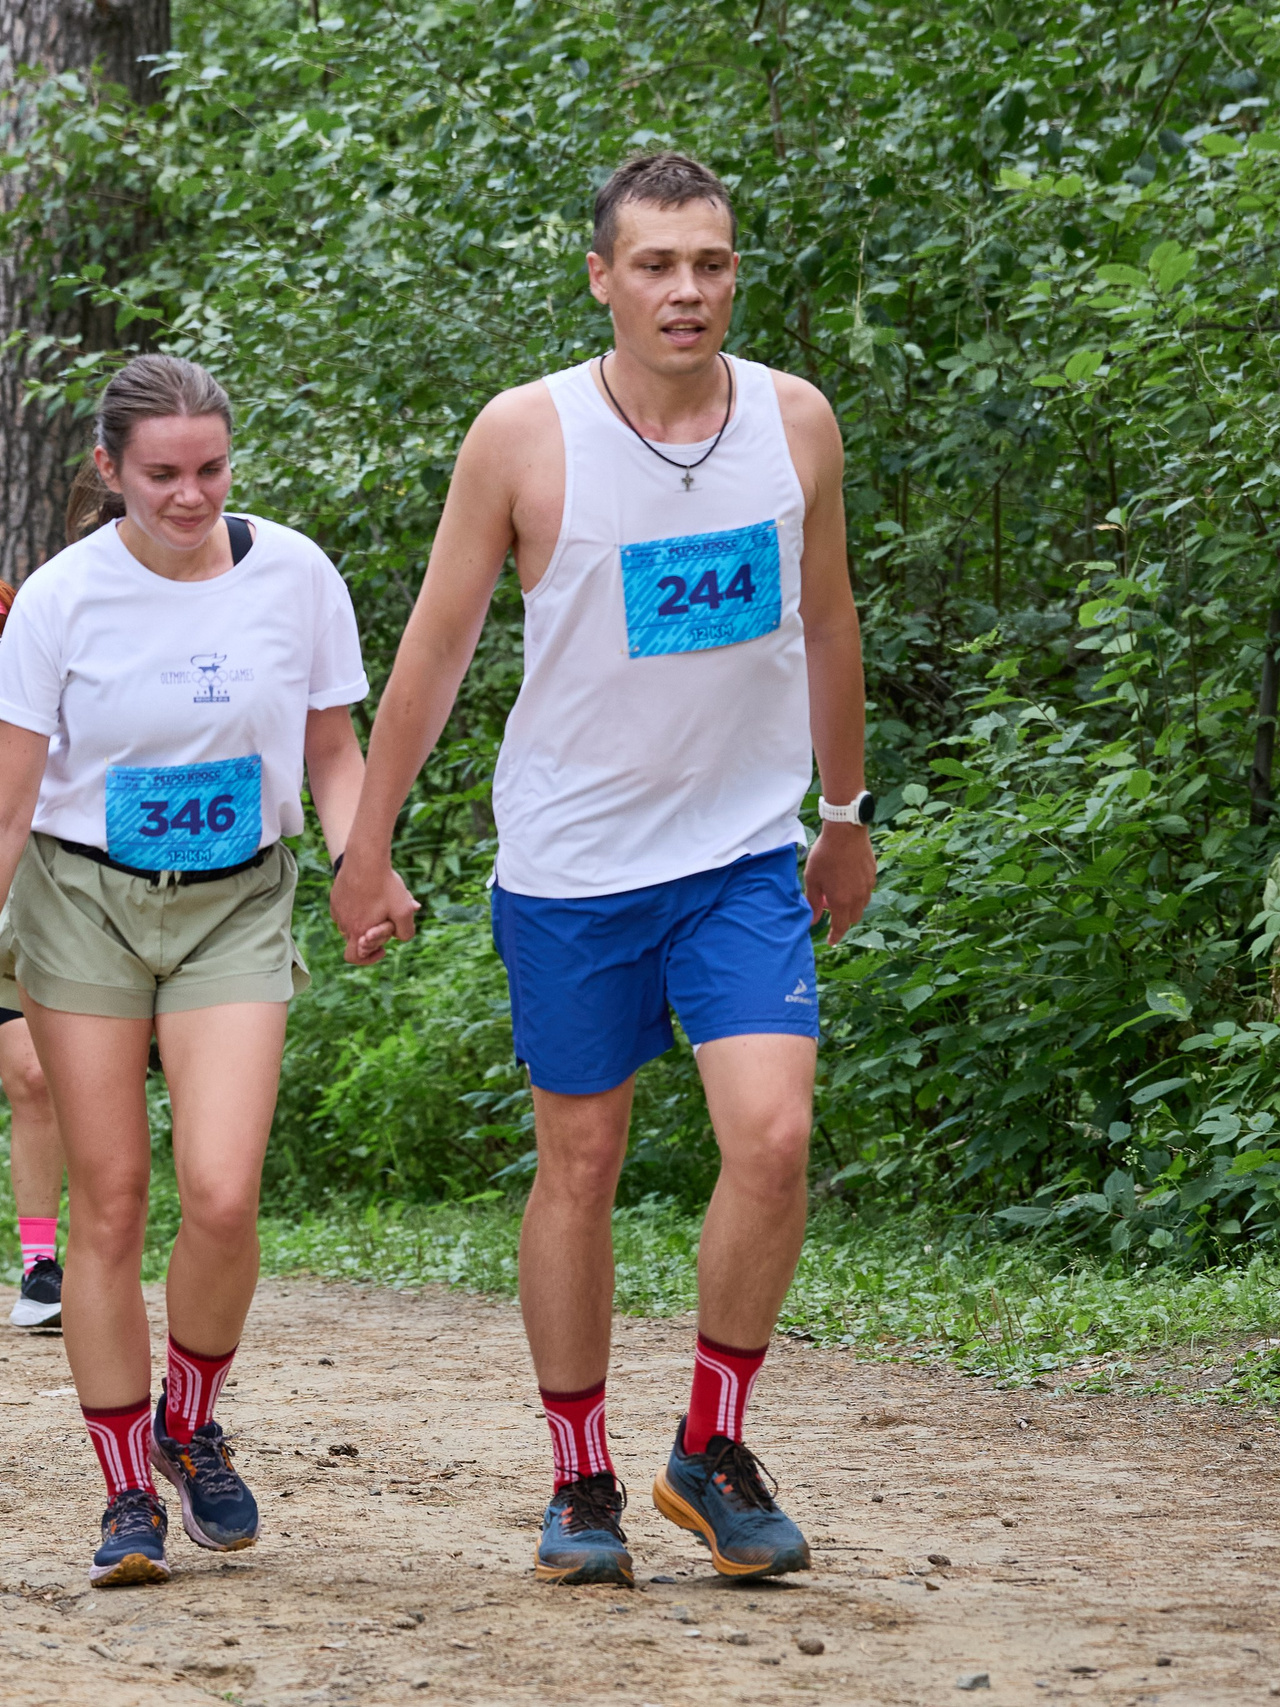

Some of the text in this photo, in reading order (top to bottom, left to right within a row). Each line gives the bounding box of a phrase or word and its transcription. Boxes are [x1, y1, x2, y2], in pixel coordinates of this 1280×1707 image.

[657, 563, 756, 616] 244
[692, 628, 709, 642] 12
[229, 668, 254, 682] GAMES
[139, 794, 236, 837] 346
[169, 850, 186, 863] 12
